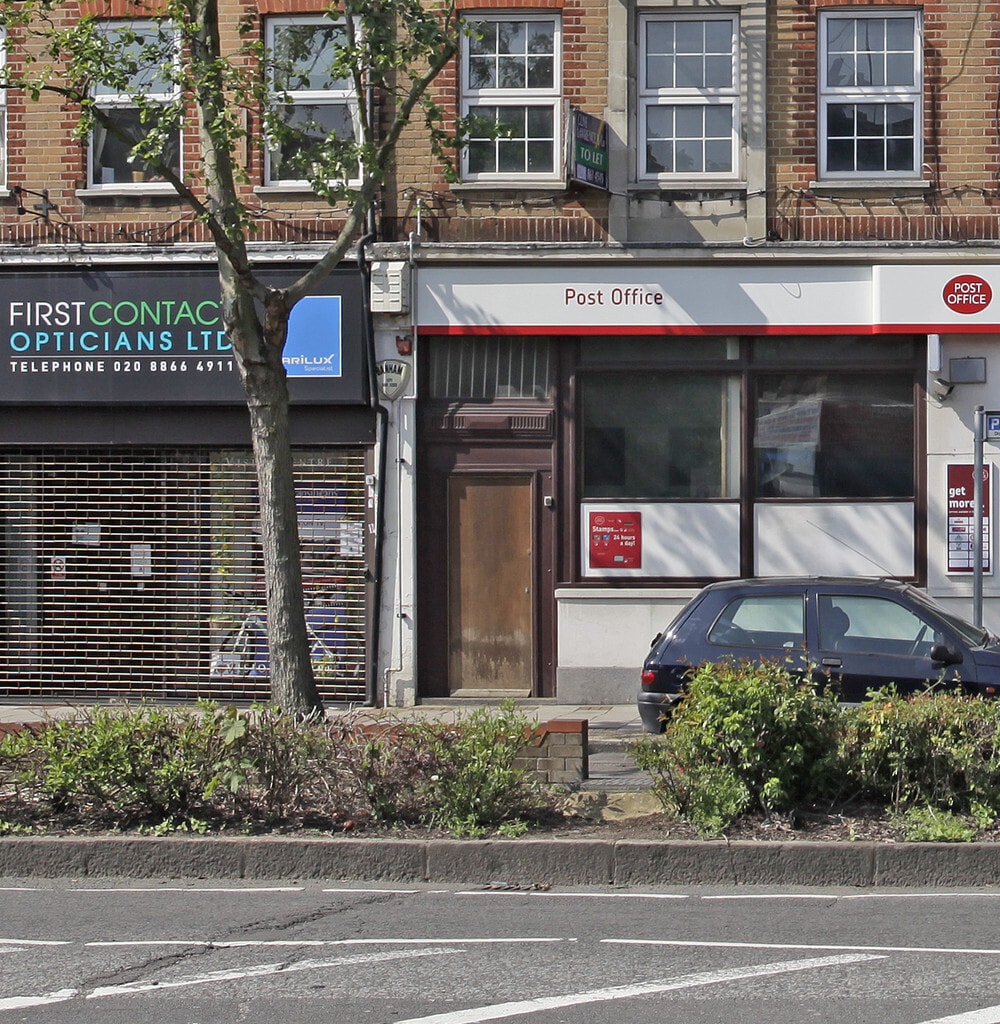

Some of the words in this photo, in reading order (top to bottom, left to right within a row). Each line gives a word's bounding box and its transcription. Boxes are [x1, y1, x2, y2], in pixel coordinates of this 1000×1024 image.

[580, 147, 591, 161] TO
[592, 151, 603, 165] LET
[954, 282, 983, 294] POST
[565, 288, 604, 305] Post
[611, 288, 663, 305] Office
[947, 294, 987, 305] OFFICE
[9, 301, 86, 326] FIRST
[89, 301, 224, 326] CONTAC
[9, 331, 174, 352] OPTICIANS
[186, 331, 234, 351] LTD
[9, 361, 105, 373] TELEPHONE
[113, 361, 142, 372] 020
[149, 361, 188, 372] 8866
[196, 361, 234, 372] 4911
[991, 418, 1000, 430] P
[948, 486, 966, 498] get
